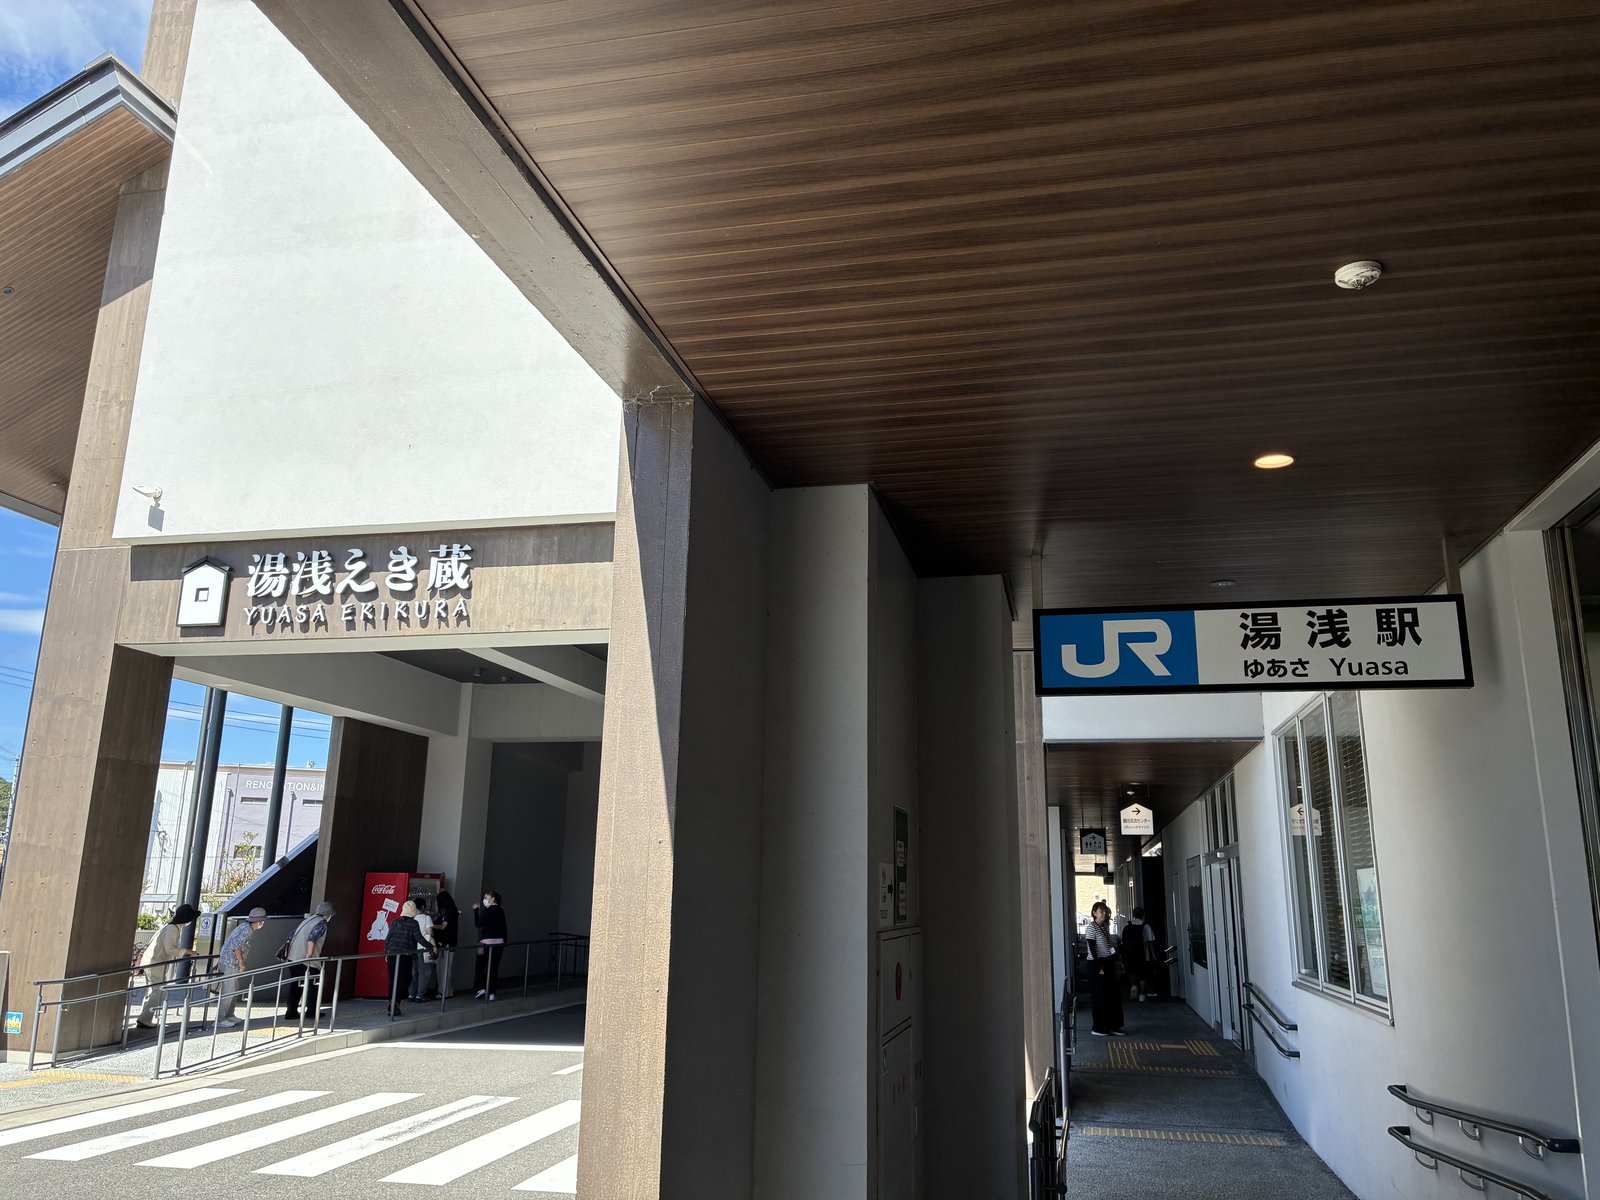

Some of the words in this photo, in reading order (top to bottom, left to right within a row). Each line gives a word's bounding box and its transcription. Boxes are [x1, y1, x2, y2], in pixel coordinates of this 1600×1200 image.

[246, 543, 472, 598] 湯浅えき蔵
[243, 603, 323, 625] YUASA
[340, 598, 469, 621] EKIKURA
[1239, 607, 1423, 651] 湯浅駅
[1061, 618, 1173, 678] JR
[1243, 657, 1310, 679] ゆあさ
[1328, 657, 1409, 676] Yuasa
